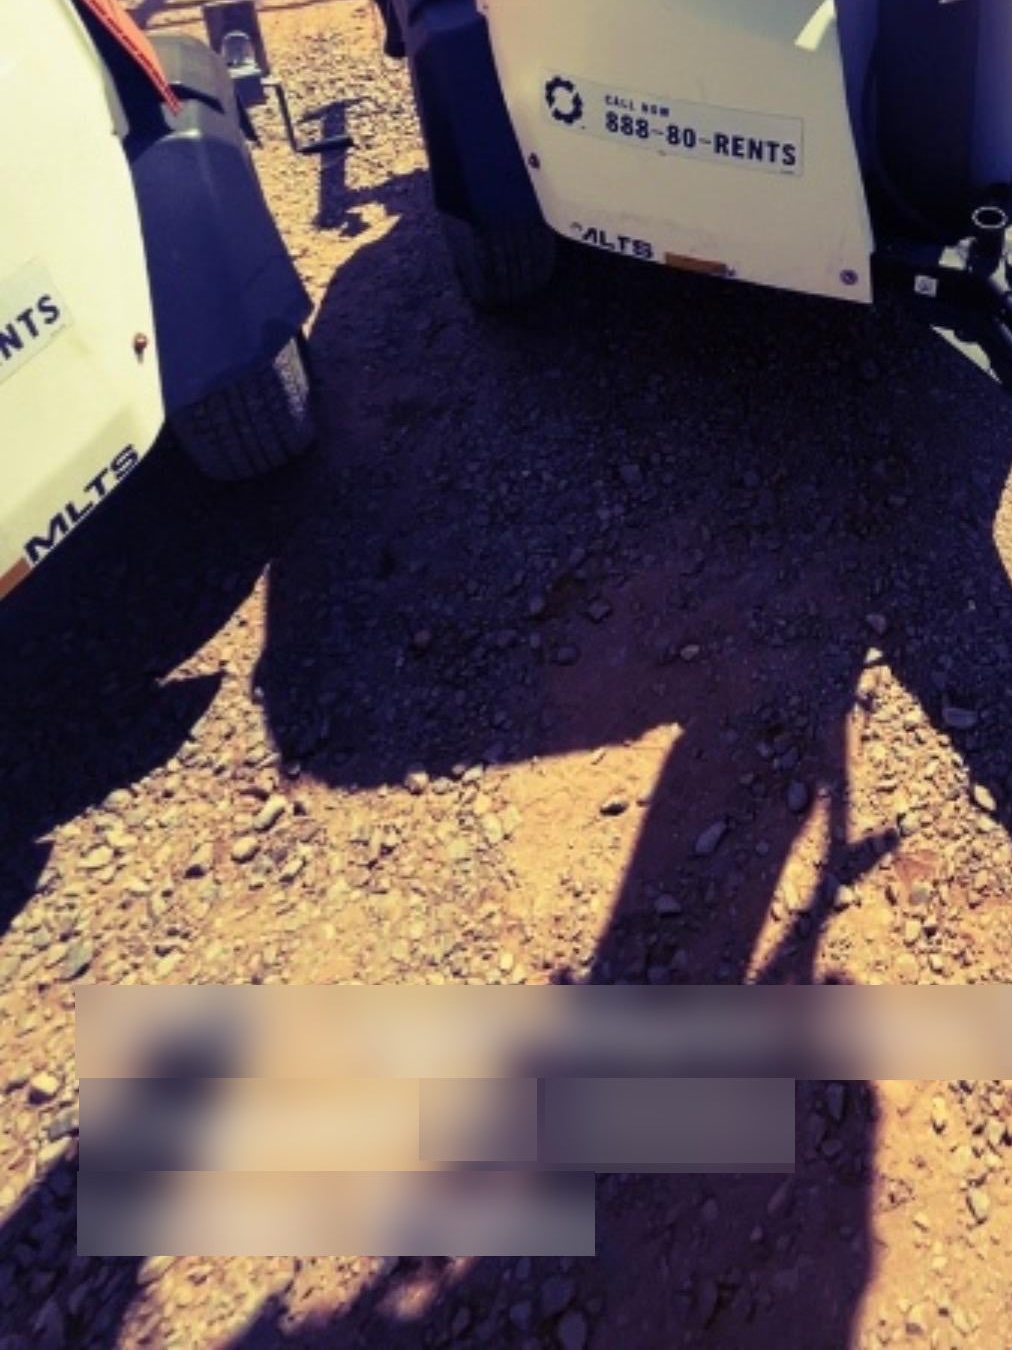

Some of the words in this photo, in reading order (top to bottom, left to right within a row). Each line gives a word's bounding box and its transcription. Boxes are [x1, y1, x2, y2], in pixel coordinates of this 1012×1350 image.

[605, 94, 635, 112] CALL
[641, 101, 670, 117] NOW
[605, 110, 796, 166] 888-80-RENTS
[24, 444, 139, 562] MLTS
